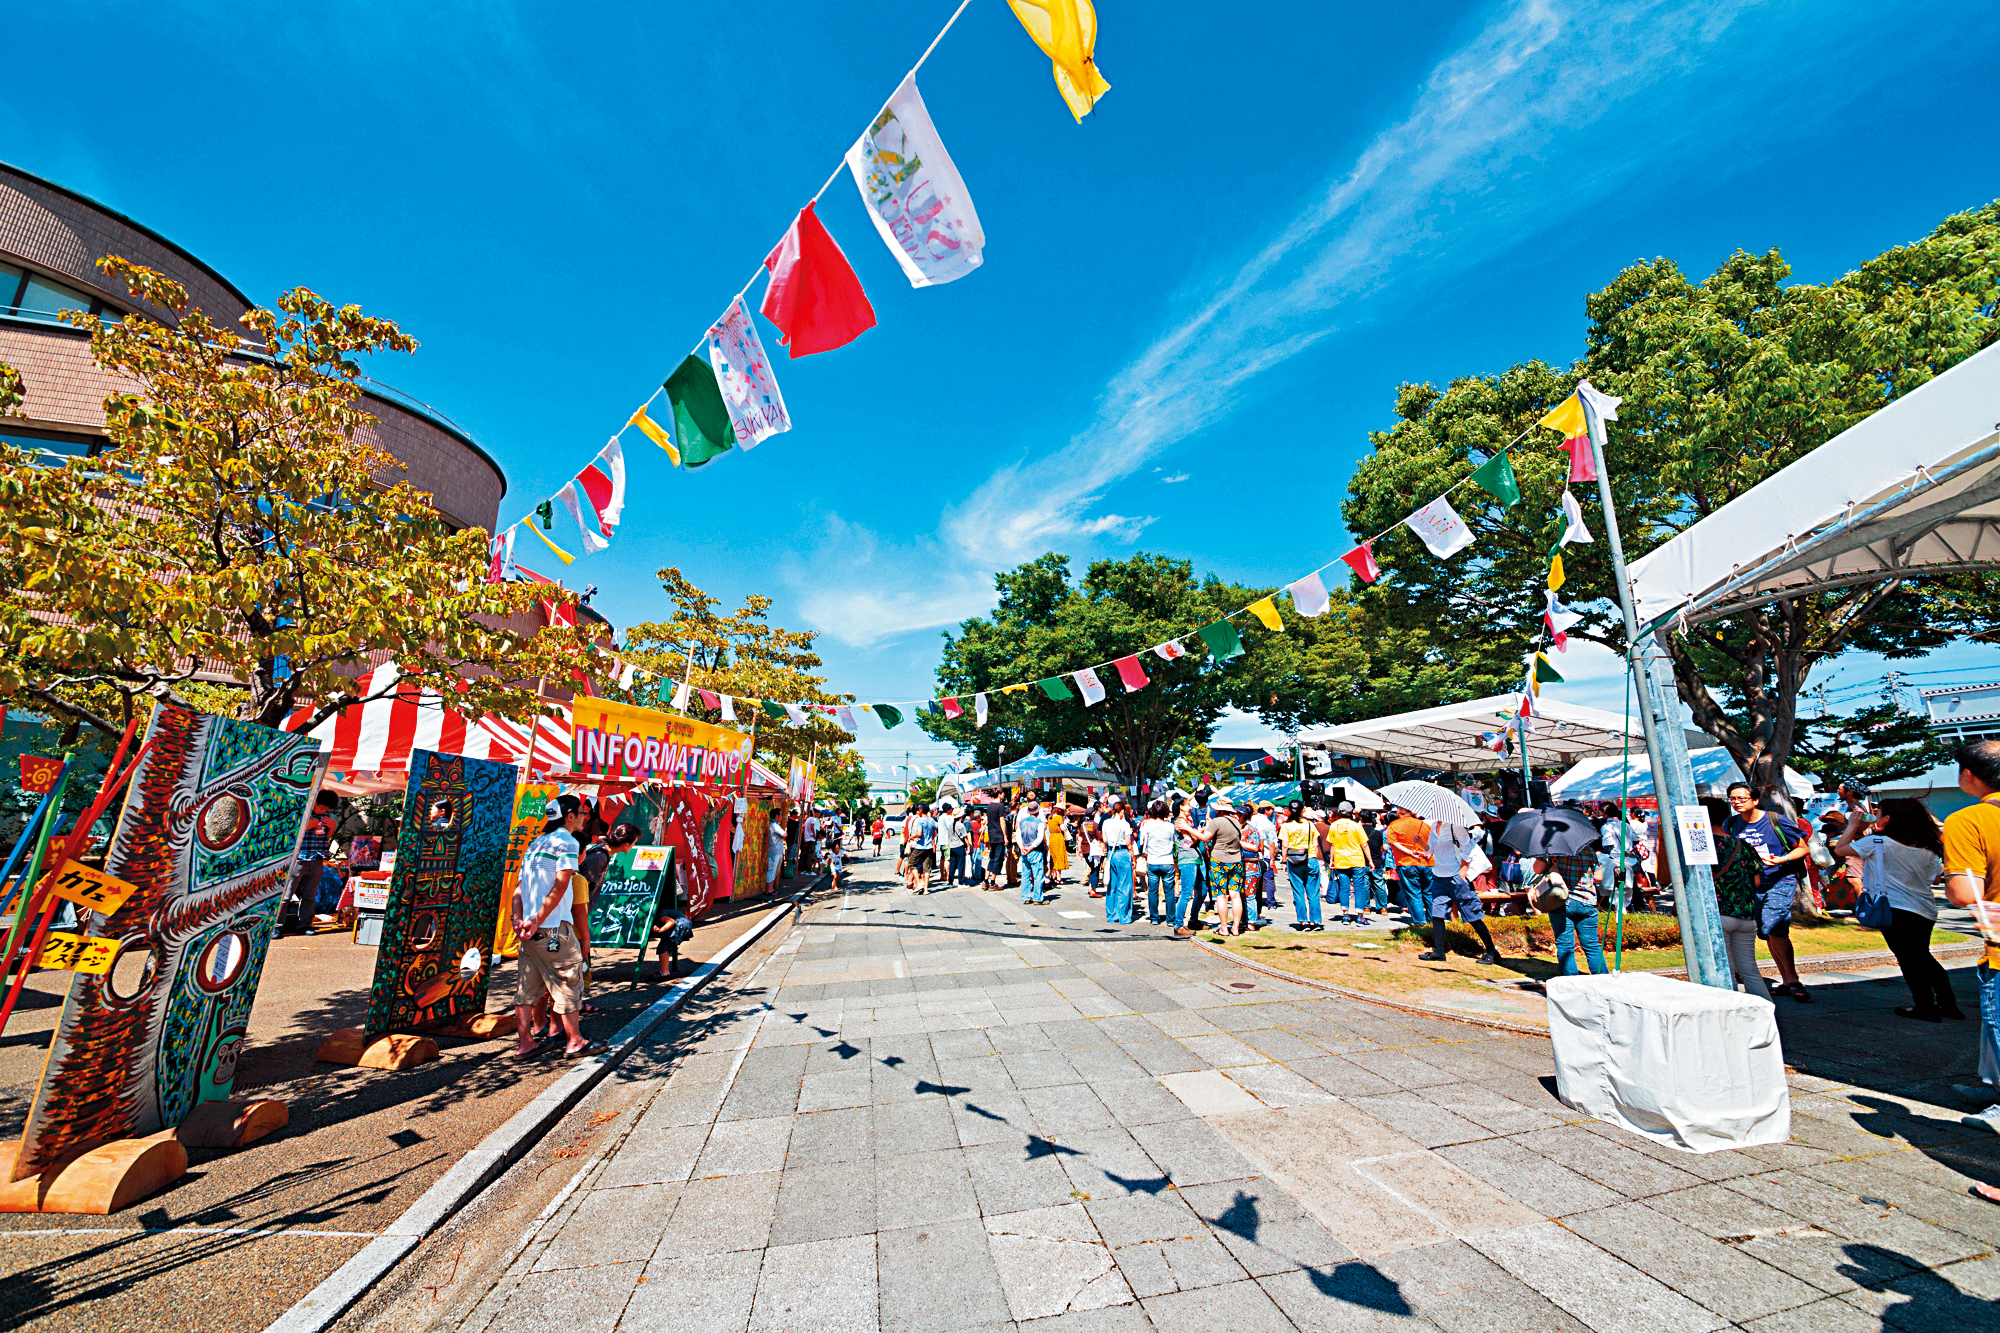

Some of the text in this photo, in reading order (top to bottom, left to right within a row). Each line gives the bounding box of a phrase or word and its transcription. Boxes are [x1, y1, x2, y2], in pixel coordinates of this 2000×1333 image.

[576, 725, 728, 778] INFORMATION
[56, 870, 106, 902] カフェ
[43, 937, 98, 954] クラブ
[53, 953, 106, 967] ステージ
